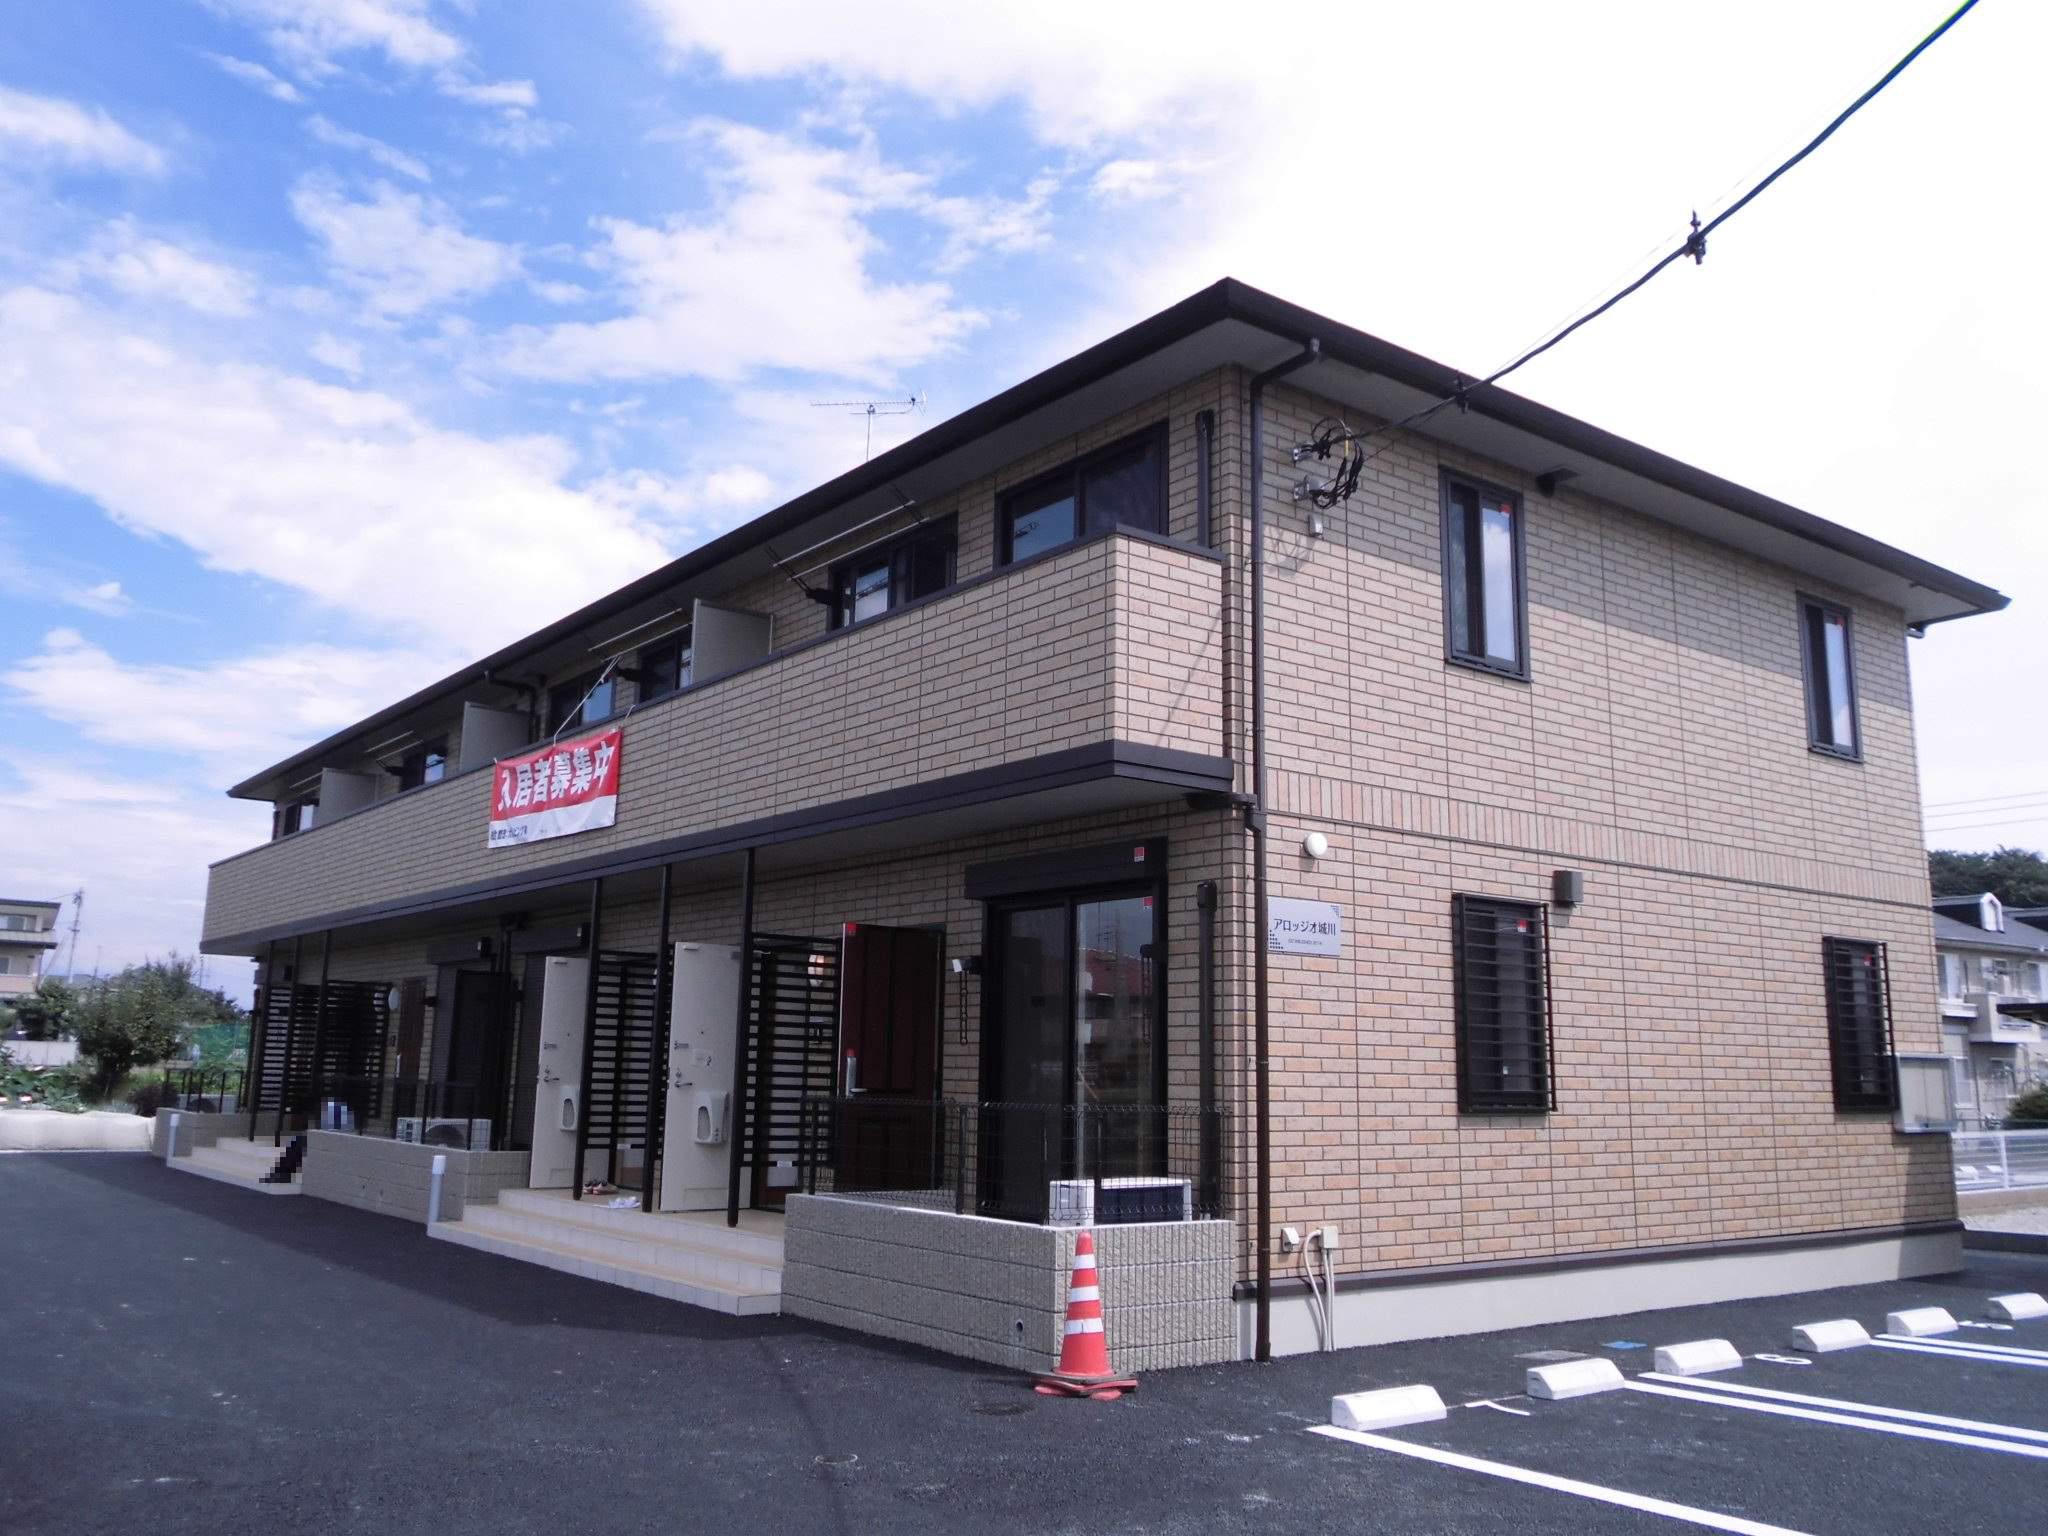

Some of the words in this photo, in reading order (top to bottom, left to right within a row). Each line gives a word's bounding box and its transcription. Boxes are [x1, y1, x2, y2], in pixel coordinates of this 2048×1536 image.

[498, 740, 615, 811] 入居者募集中
[1754, 1353, 1812, 1365] 8
[1465, 1400, 1531, 1416] 7
